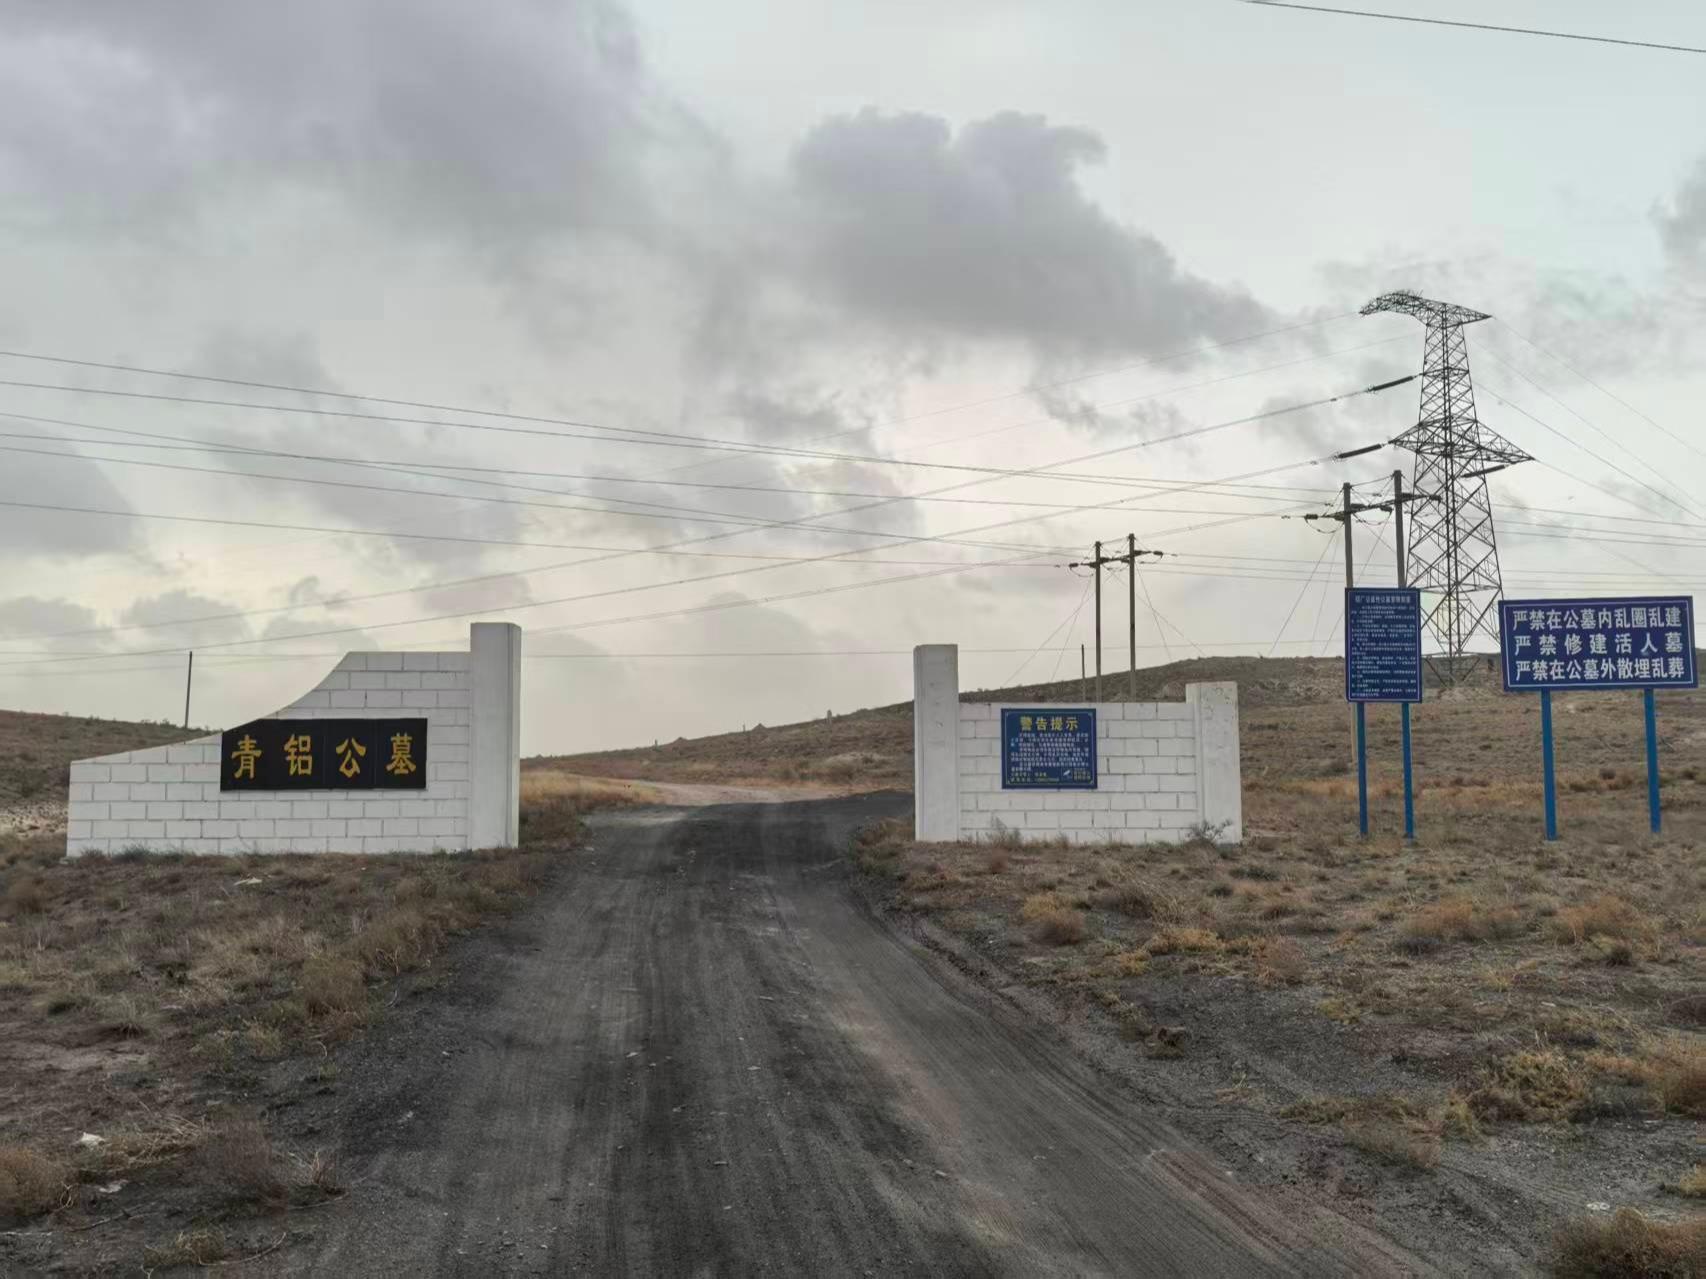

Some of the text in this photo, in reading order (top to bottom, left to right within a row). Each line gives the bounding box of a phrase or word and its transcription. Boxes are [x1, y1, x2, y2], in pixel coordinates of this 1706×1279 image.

[1512, 606, 1682, 631] 严禁在公墓内乱圈乱建
[1514, 632, 1684, 656] 严禁修建活人墓
[1515, 657, 1685, 681] 严禁在公墓外散埋乱葬
[1020, 716, 1079, 731] 警告提示
[231, 732, 416, 779] 青铝公墓
